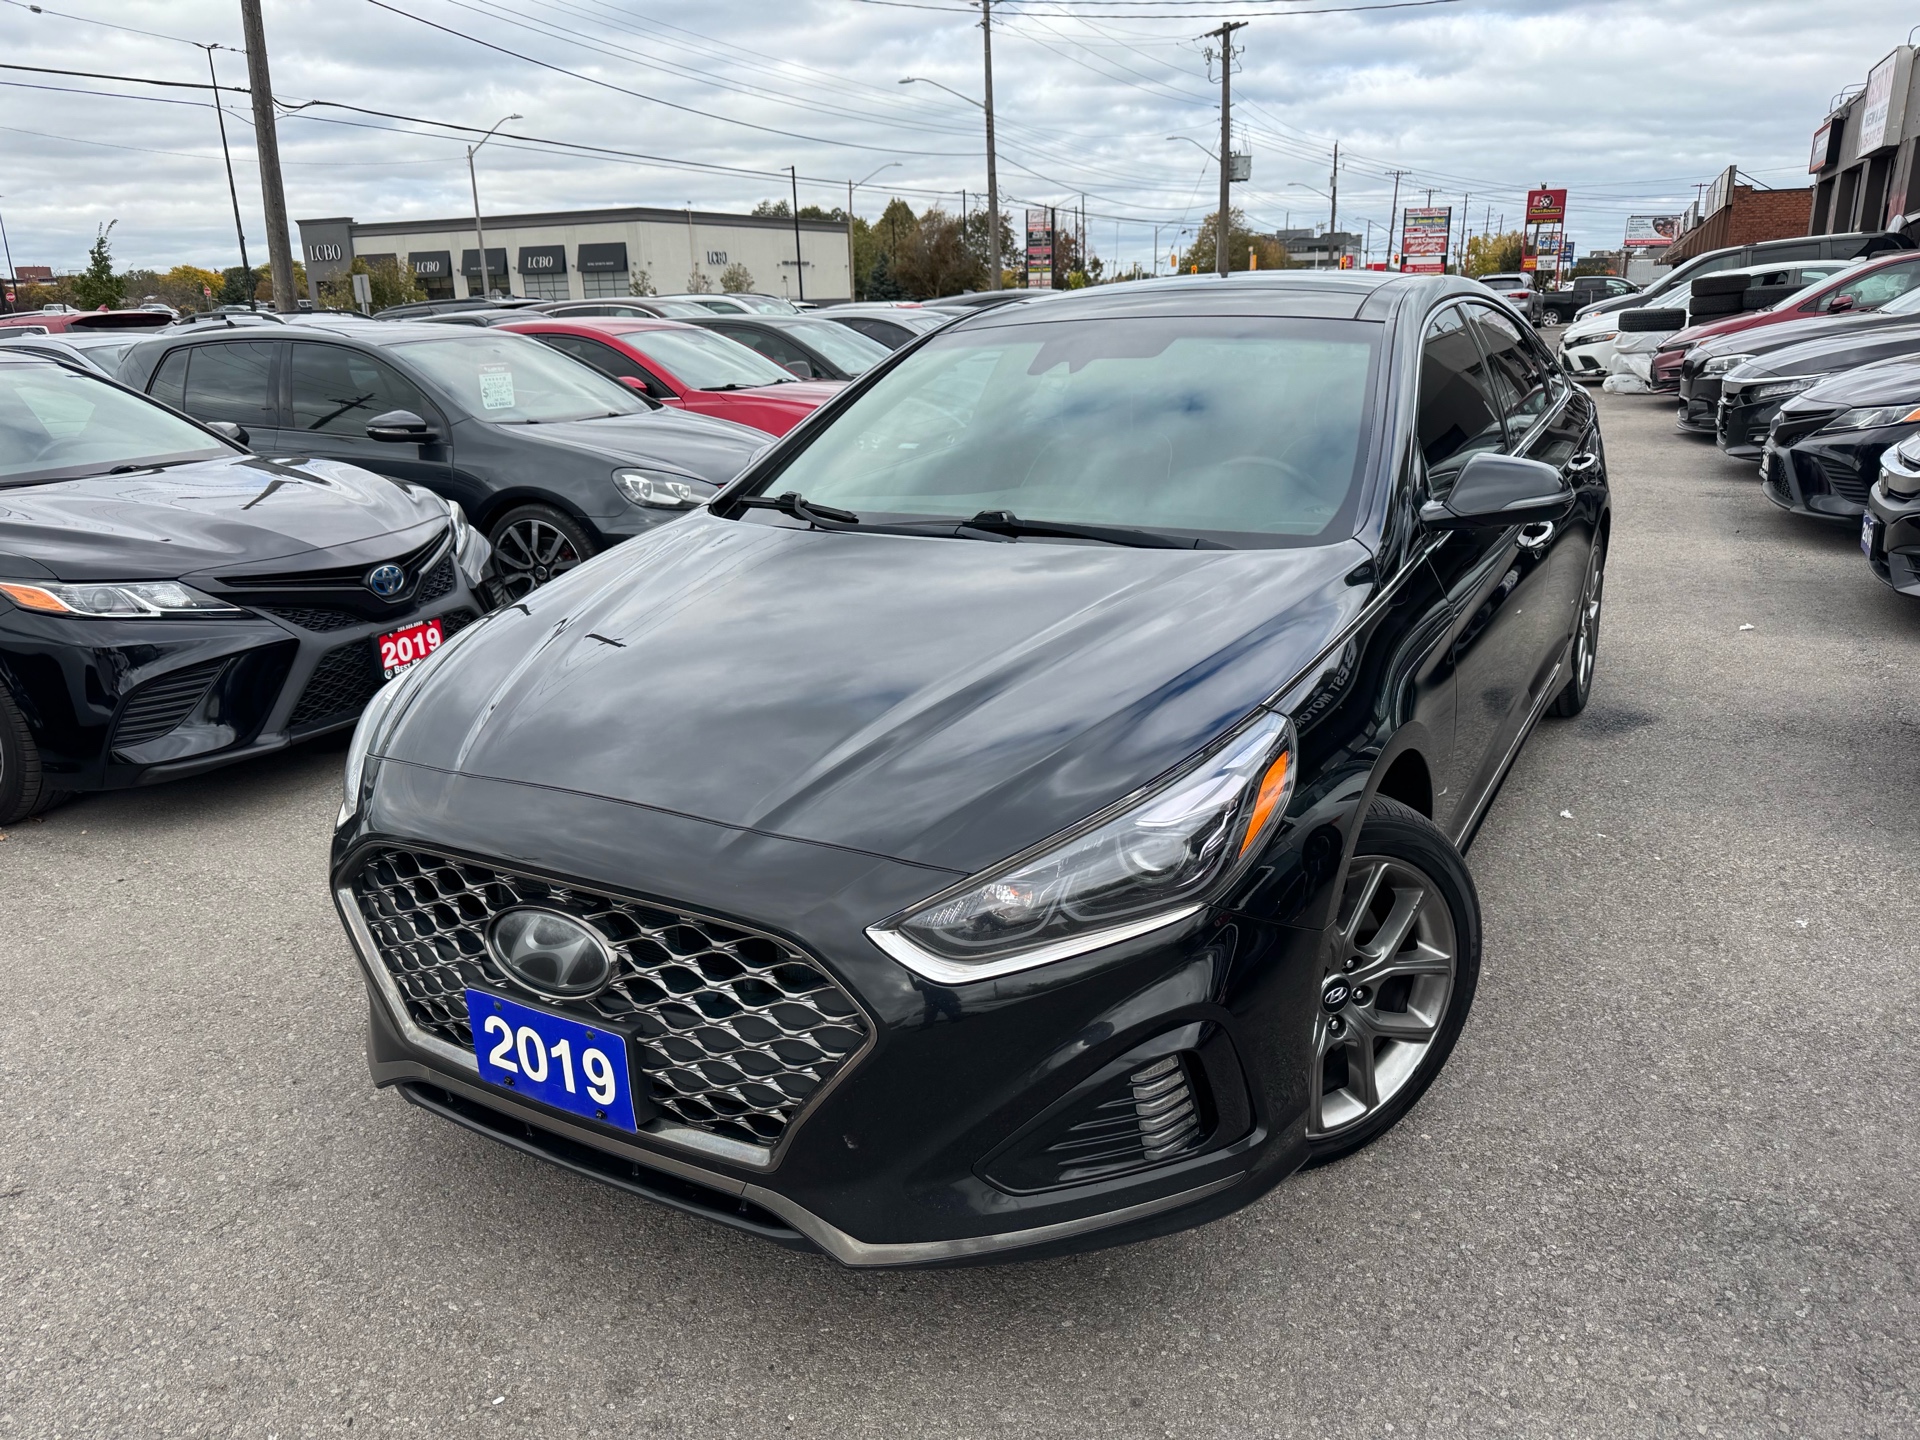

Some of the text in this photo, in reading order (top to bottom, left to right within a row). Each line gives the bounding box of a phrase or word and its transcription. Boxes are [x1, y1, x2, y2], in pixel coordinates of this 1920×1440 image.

[309, 243, 342, 261] LCBO
[707, 251, 727, 265] LCBO
[416, 261, 440, 273] LCBO
[528, 255, 553, 268] LCBO
[381, 627, 441, 668] 2019
[484, 1015, 616, 1106] 2019
